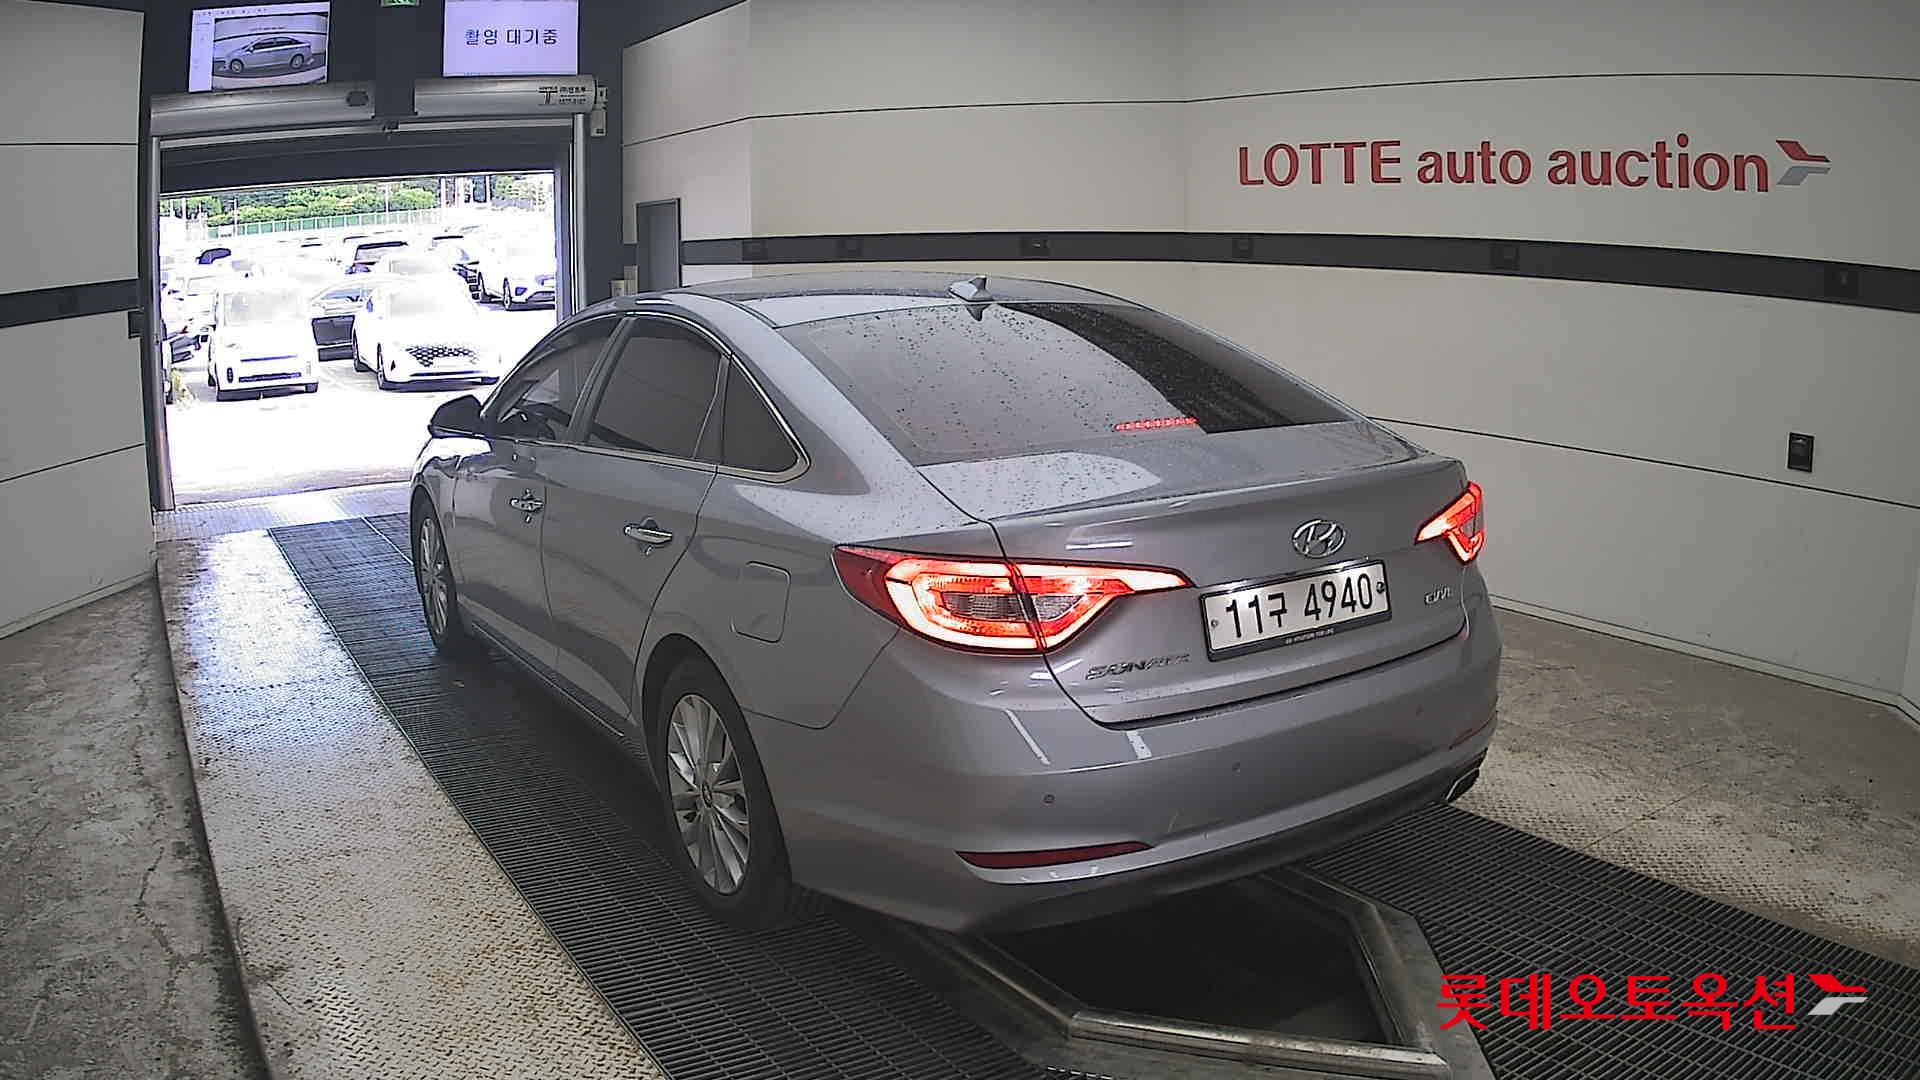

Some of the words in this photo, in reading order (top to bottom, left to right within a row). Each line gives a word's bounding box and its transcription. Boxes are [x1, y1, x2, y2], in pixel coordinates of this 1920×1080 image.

[506, 29, 558, 45] 대기중
[1239, 140, 1401, 186] LOTTE
[1417, 141, 1532, 185] auto
[1547, 133, 1769, 193] auction
[1225, 593, 1288, 639] 11구
[1304, 573, 1373, 621] 4940
